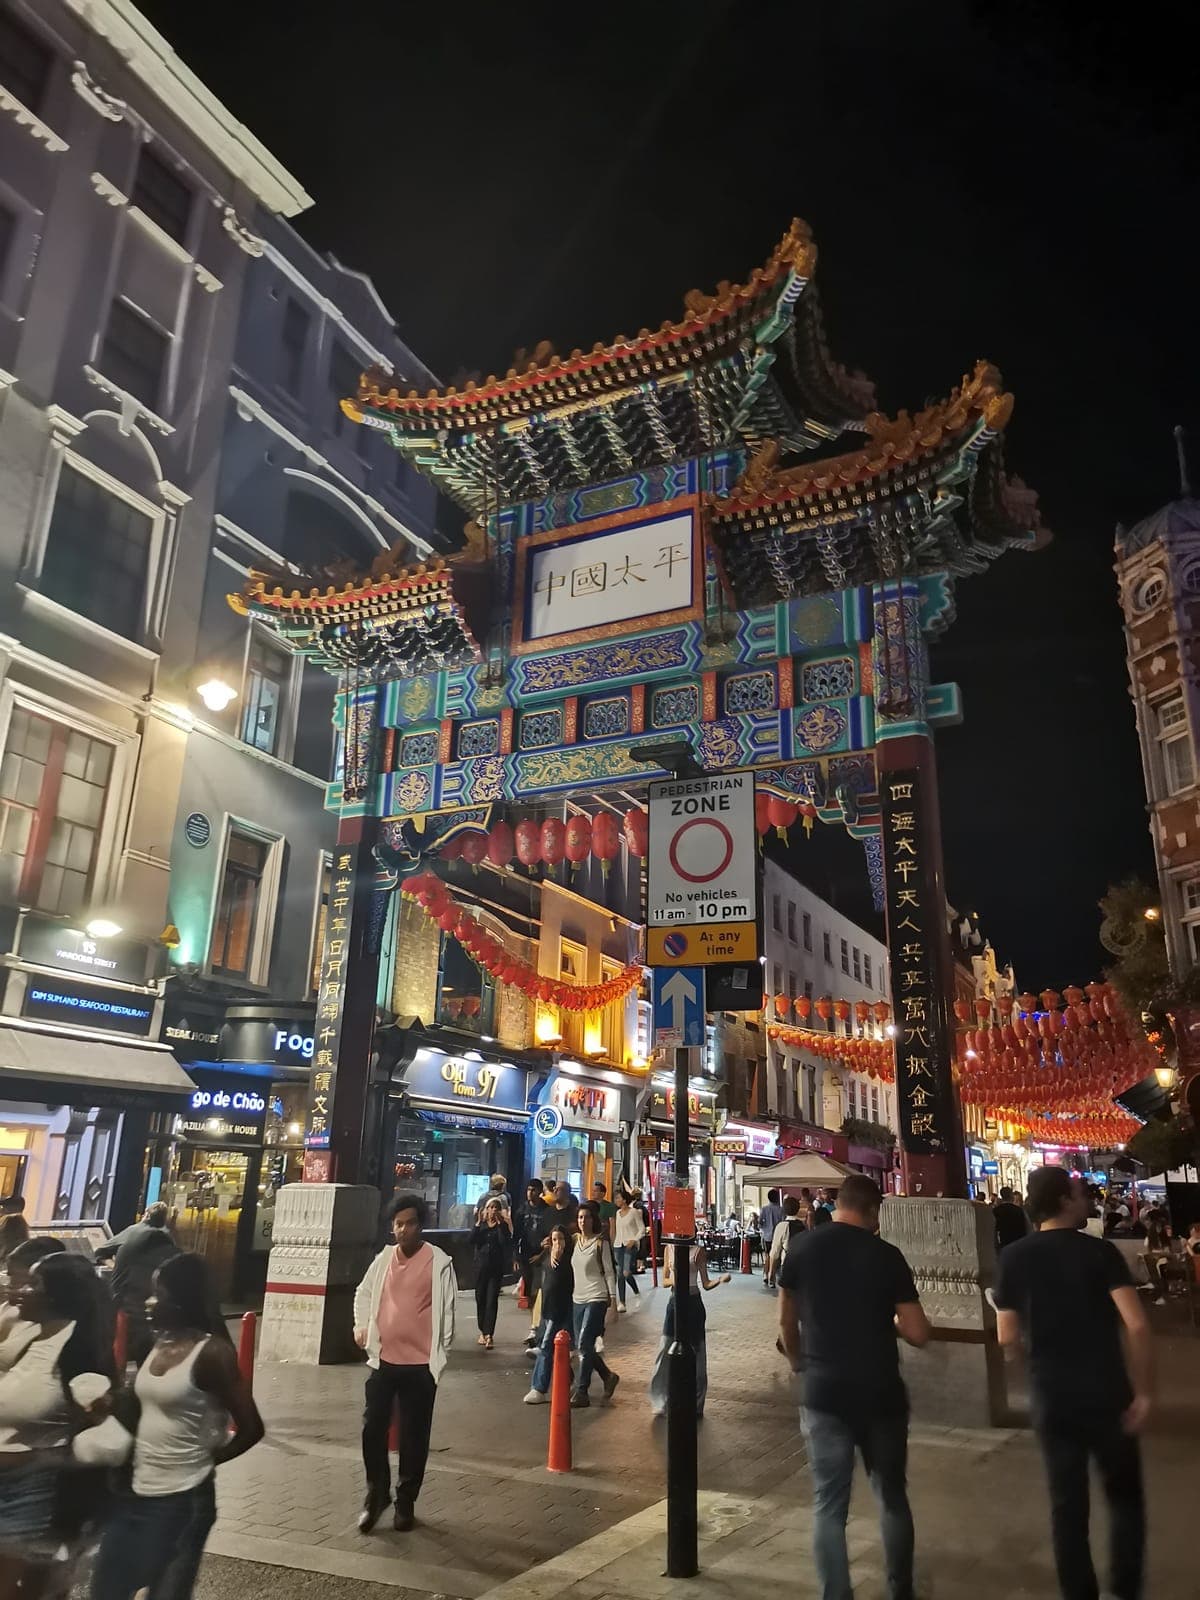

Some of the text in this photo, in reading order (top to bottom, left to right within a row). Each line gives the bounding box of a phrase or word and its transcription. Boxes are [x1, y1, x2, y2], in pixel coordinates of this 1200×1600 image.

[533, 542, 690, 606] 中國太平
[660, 778, 743, 797] PEDESTRIAN
[671, 794, 731, 816] ZONE
[665, 888, 738, 903] No vehicles
[719, 931, 741, 942] any
[706, 944, 735, 956] time
[31, 991, 150, 1018] DIM SUM AND SEAFOOD RESTAURANT
[191, 1031, 219, 1044] HOUSE
[441, 1062, 500, 1099] Old 97
[452, 1081, 476, 1097] Town
[213, 1090, 230, 1108] de
[233, 1092, 265, 1111] Chão
[234, 1125, 258, 1135] HOUSE
